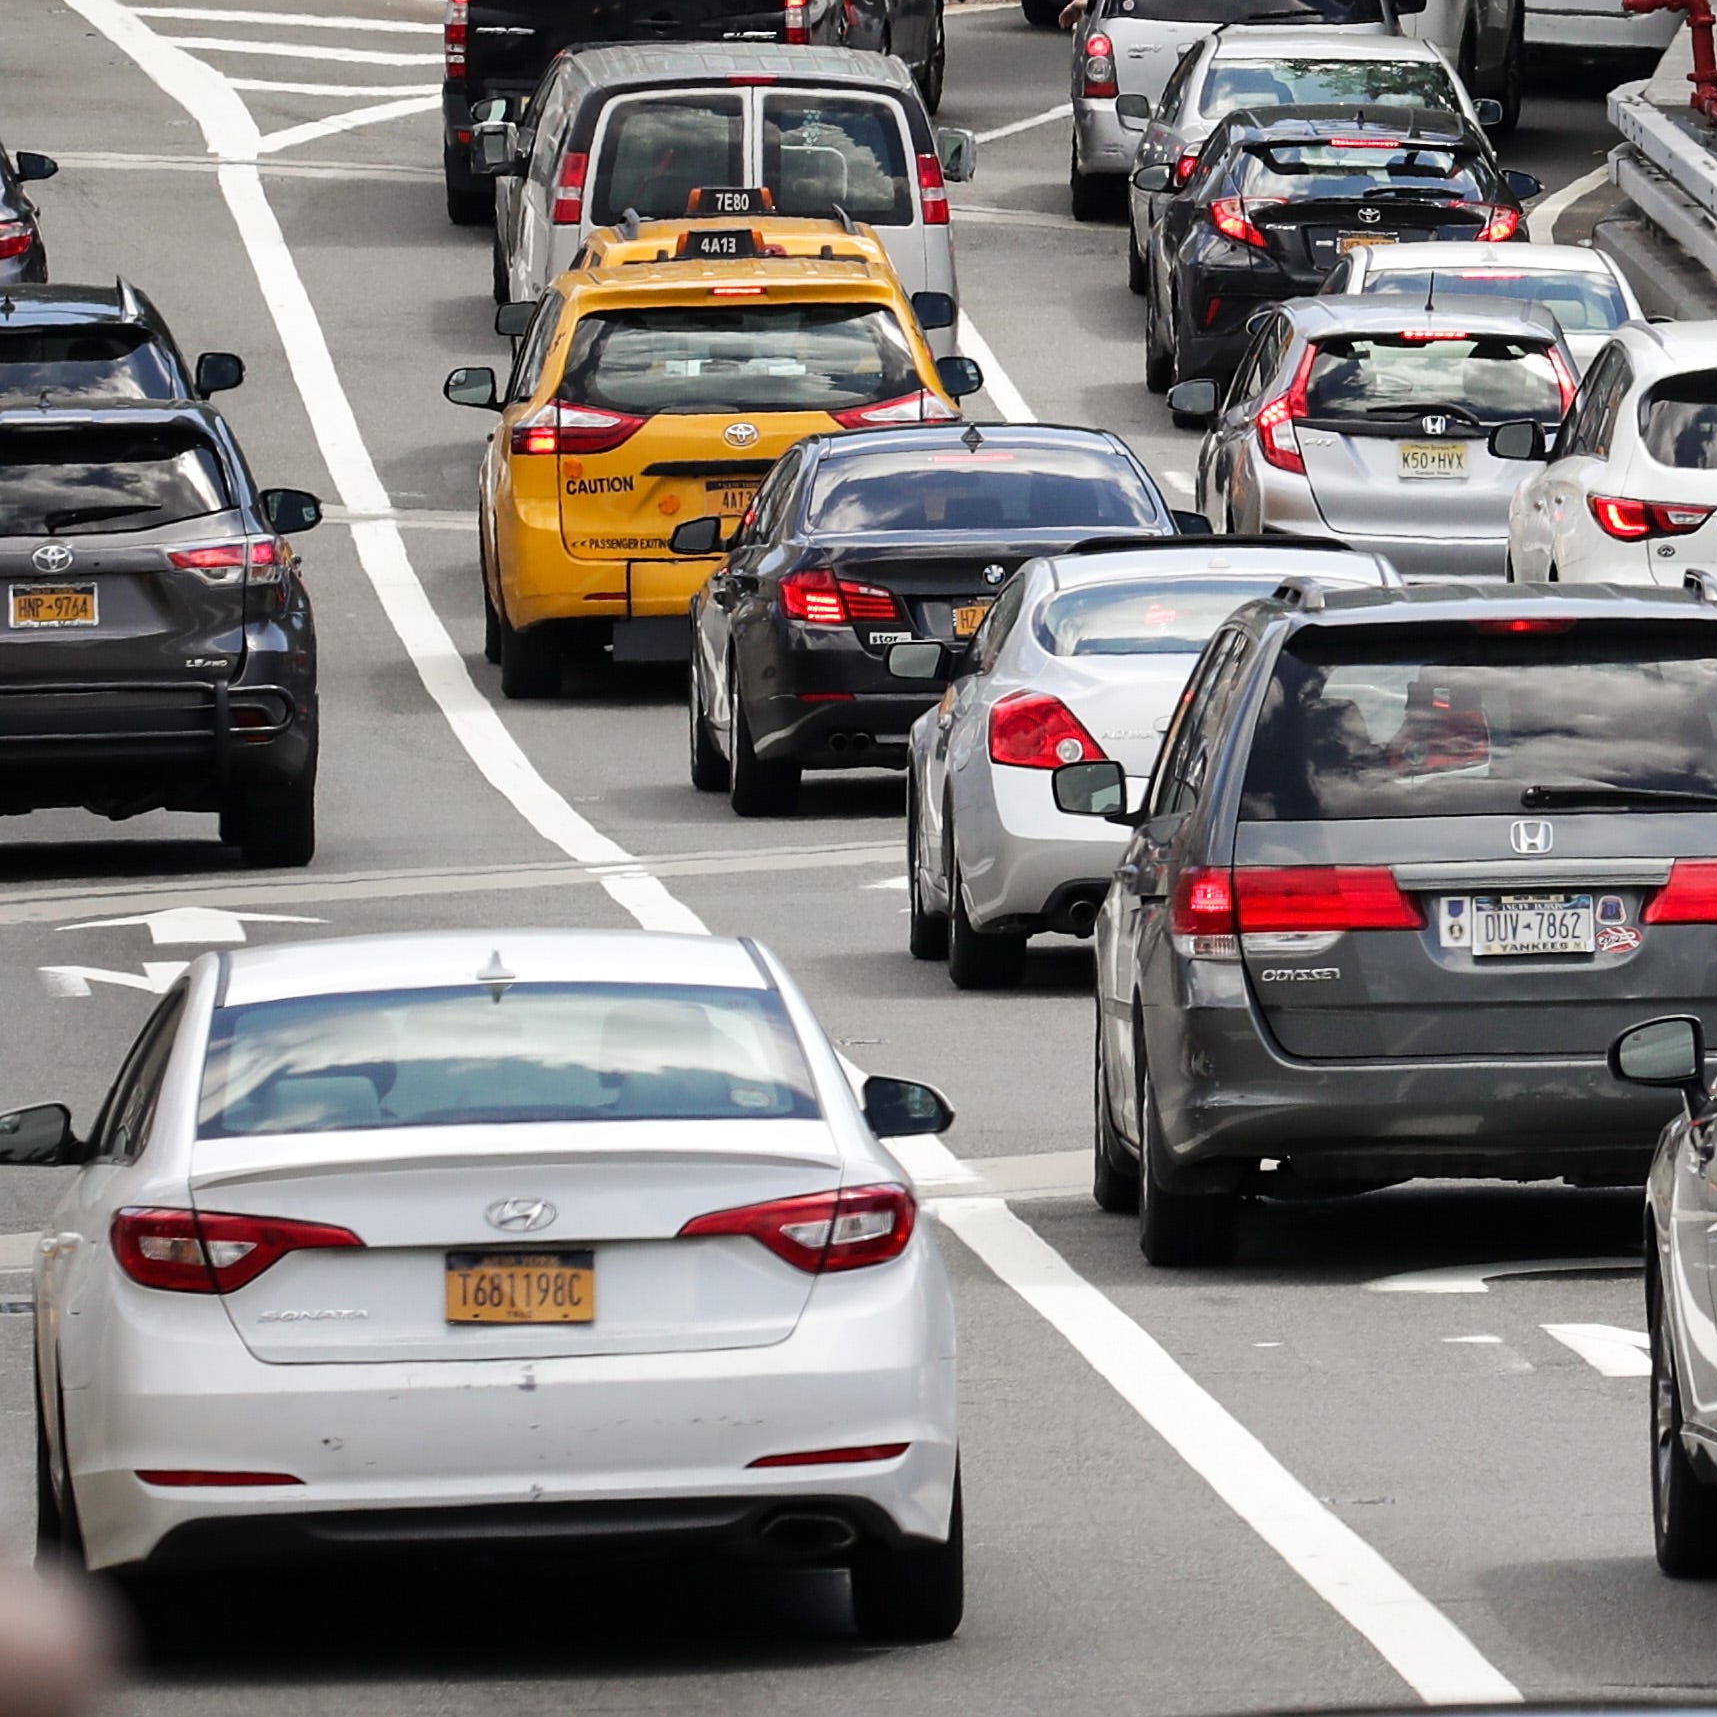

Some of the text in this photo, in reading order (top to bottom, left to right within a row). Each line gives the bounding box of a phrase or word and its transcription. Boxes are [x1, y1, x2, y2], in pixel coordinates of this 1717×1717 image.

[715, 193, 749, 211] 7E80
[701, 237, 736, 253] 4A13
[566, 476, 634, 495] CAUTION
[589, 538, 670, 549] PASSENGER EXITIN
[1500, 942, 1568, 952] YANKEES
[458, 1272, 581, 1308] T681198C
[258, 1308, 369, 1323] SONATA
